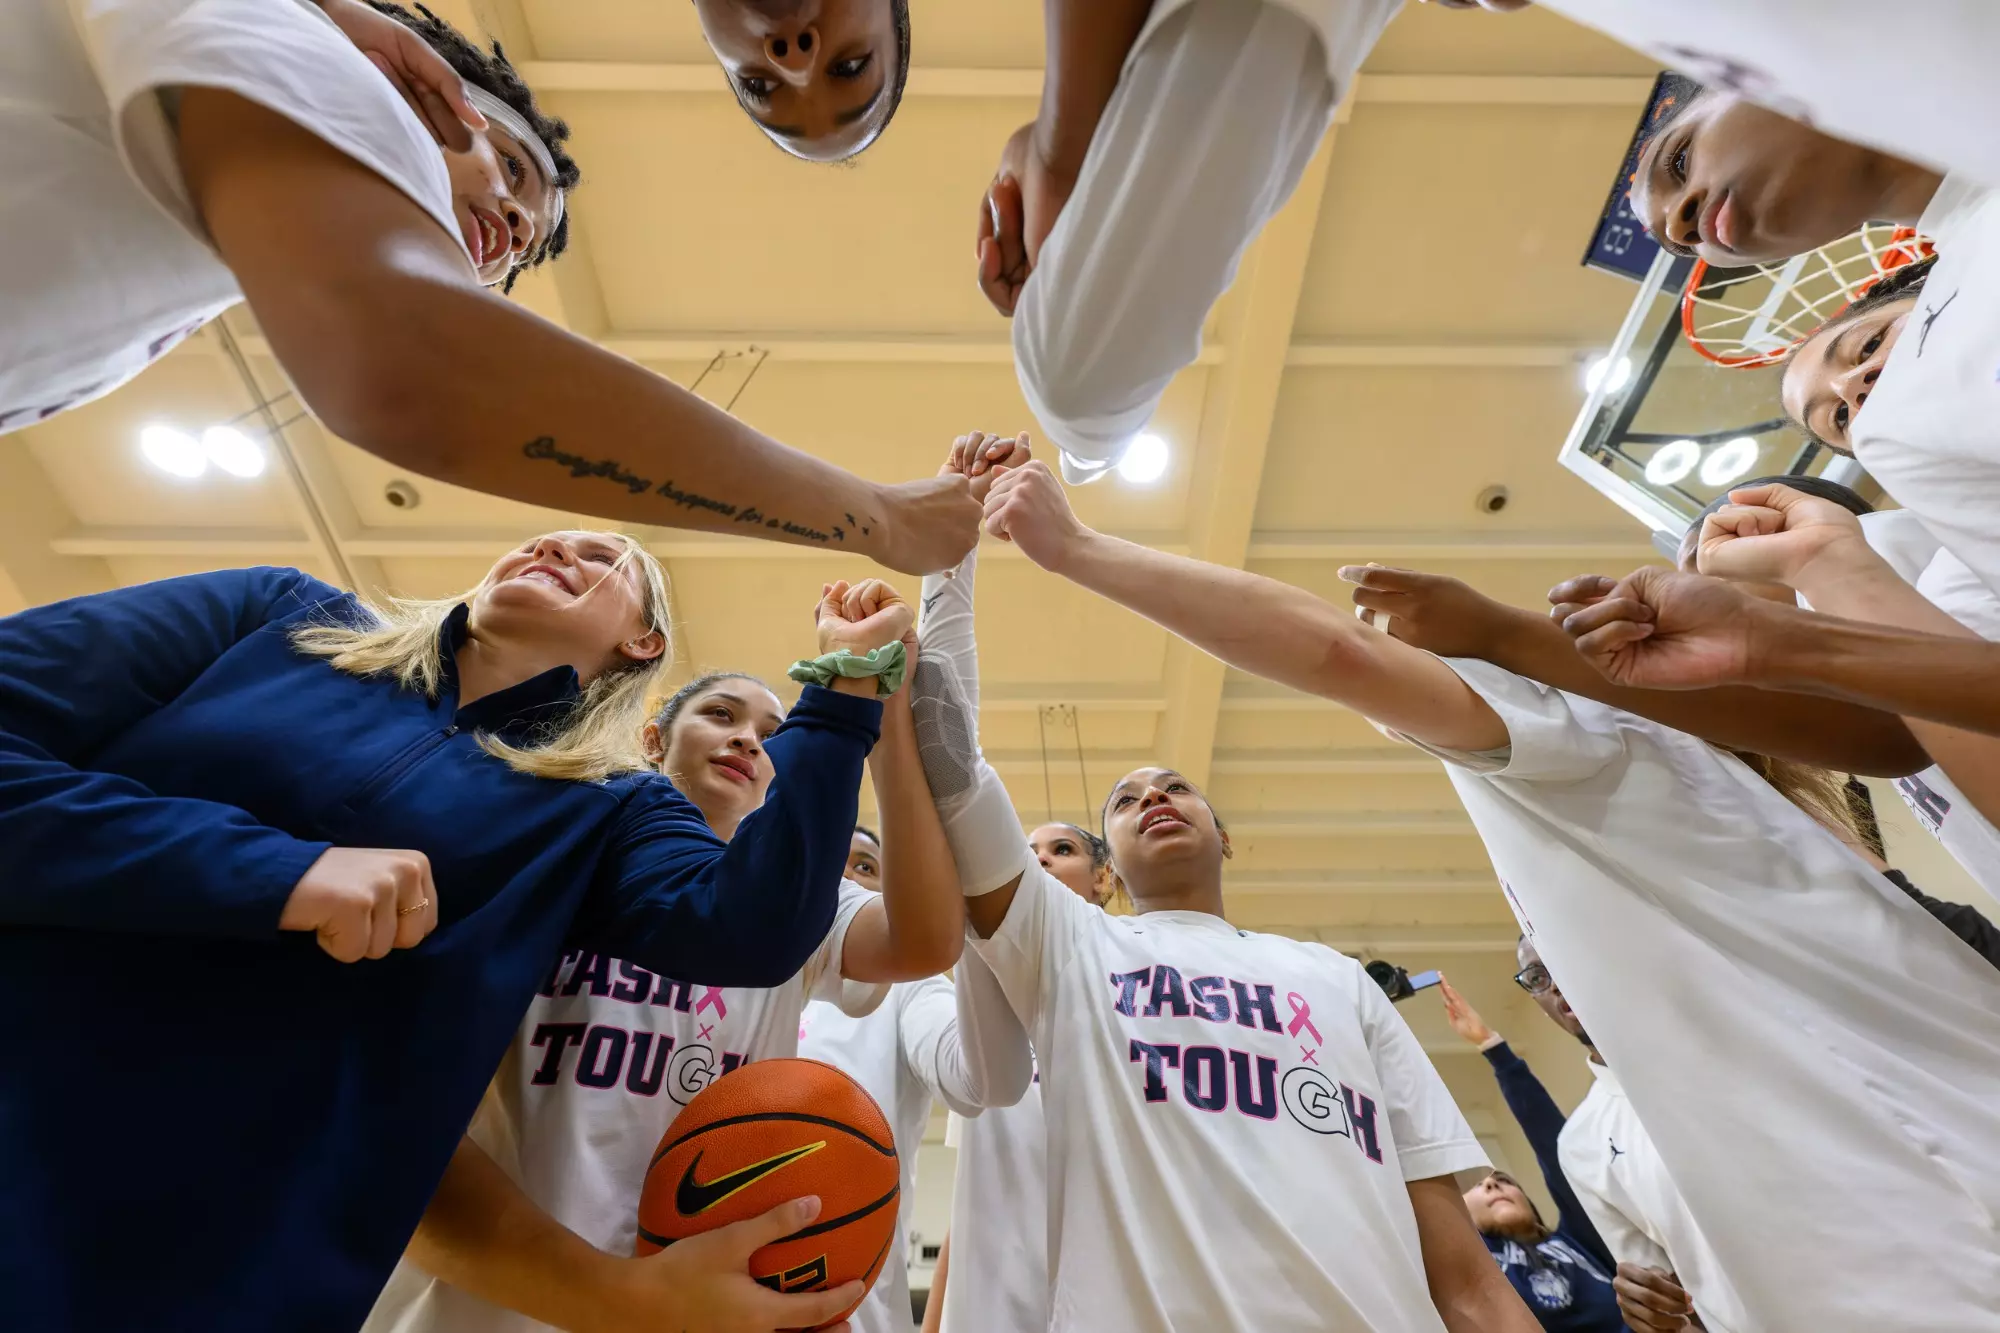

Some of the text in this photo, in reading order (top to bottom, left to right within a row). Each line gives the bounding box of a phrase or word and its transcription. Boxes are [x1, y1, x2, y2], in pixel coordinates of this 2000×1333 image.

[734, 507, 763, 522] for
[766, 518, 780, 528] a
[1109, 964, 1285, 1035] TASH
[1129, 1038, 1384, 1165] TOUGH
